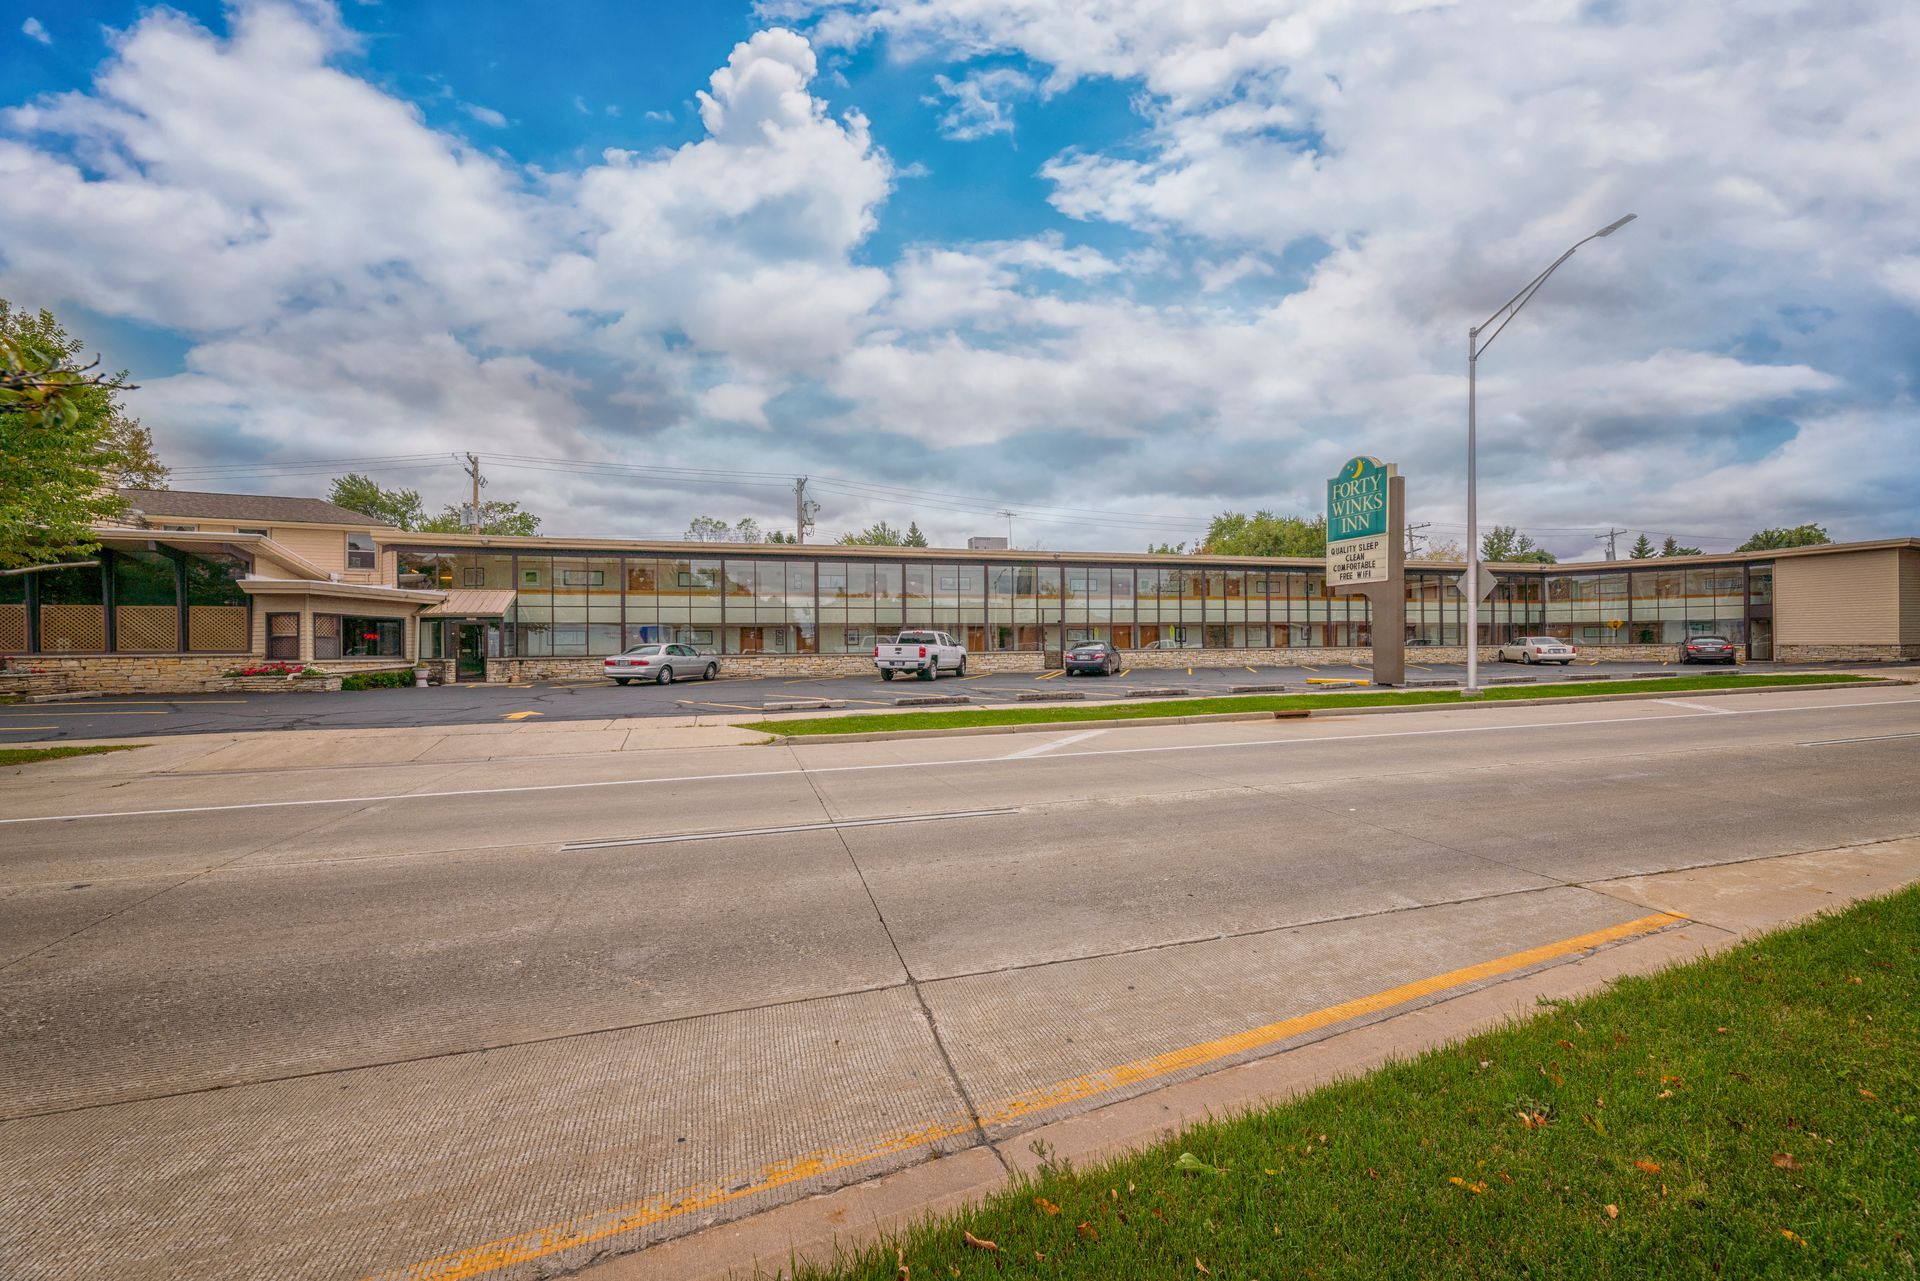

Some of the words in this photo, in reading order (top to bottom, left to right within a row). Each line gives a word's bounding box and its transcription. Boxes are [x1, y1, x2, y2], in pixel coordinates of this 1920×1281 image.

[1333, 473, 1382, 500] FORTY
[1332, 493, 1382, 516] WINKS
[1342, 514, 1370, 533] INN
[1331, 545, 1356, 555] QUALITY
[1359, 541, 1379, 551] SLEEP
[1345, 553, 1365, 562] CLEAN
[1333, 560, 1376, 572] COMFORTABLE
[1340, 572, 1353, 580] FREE
[1357, 570, 1371, 578] WIFI
